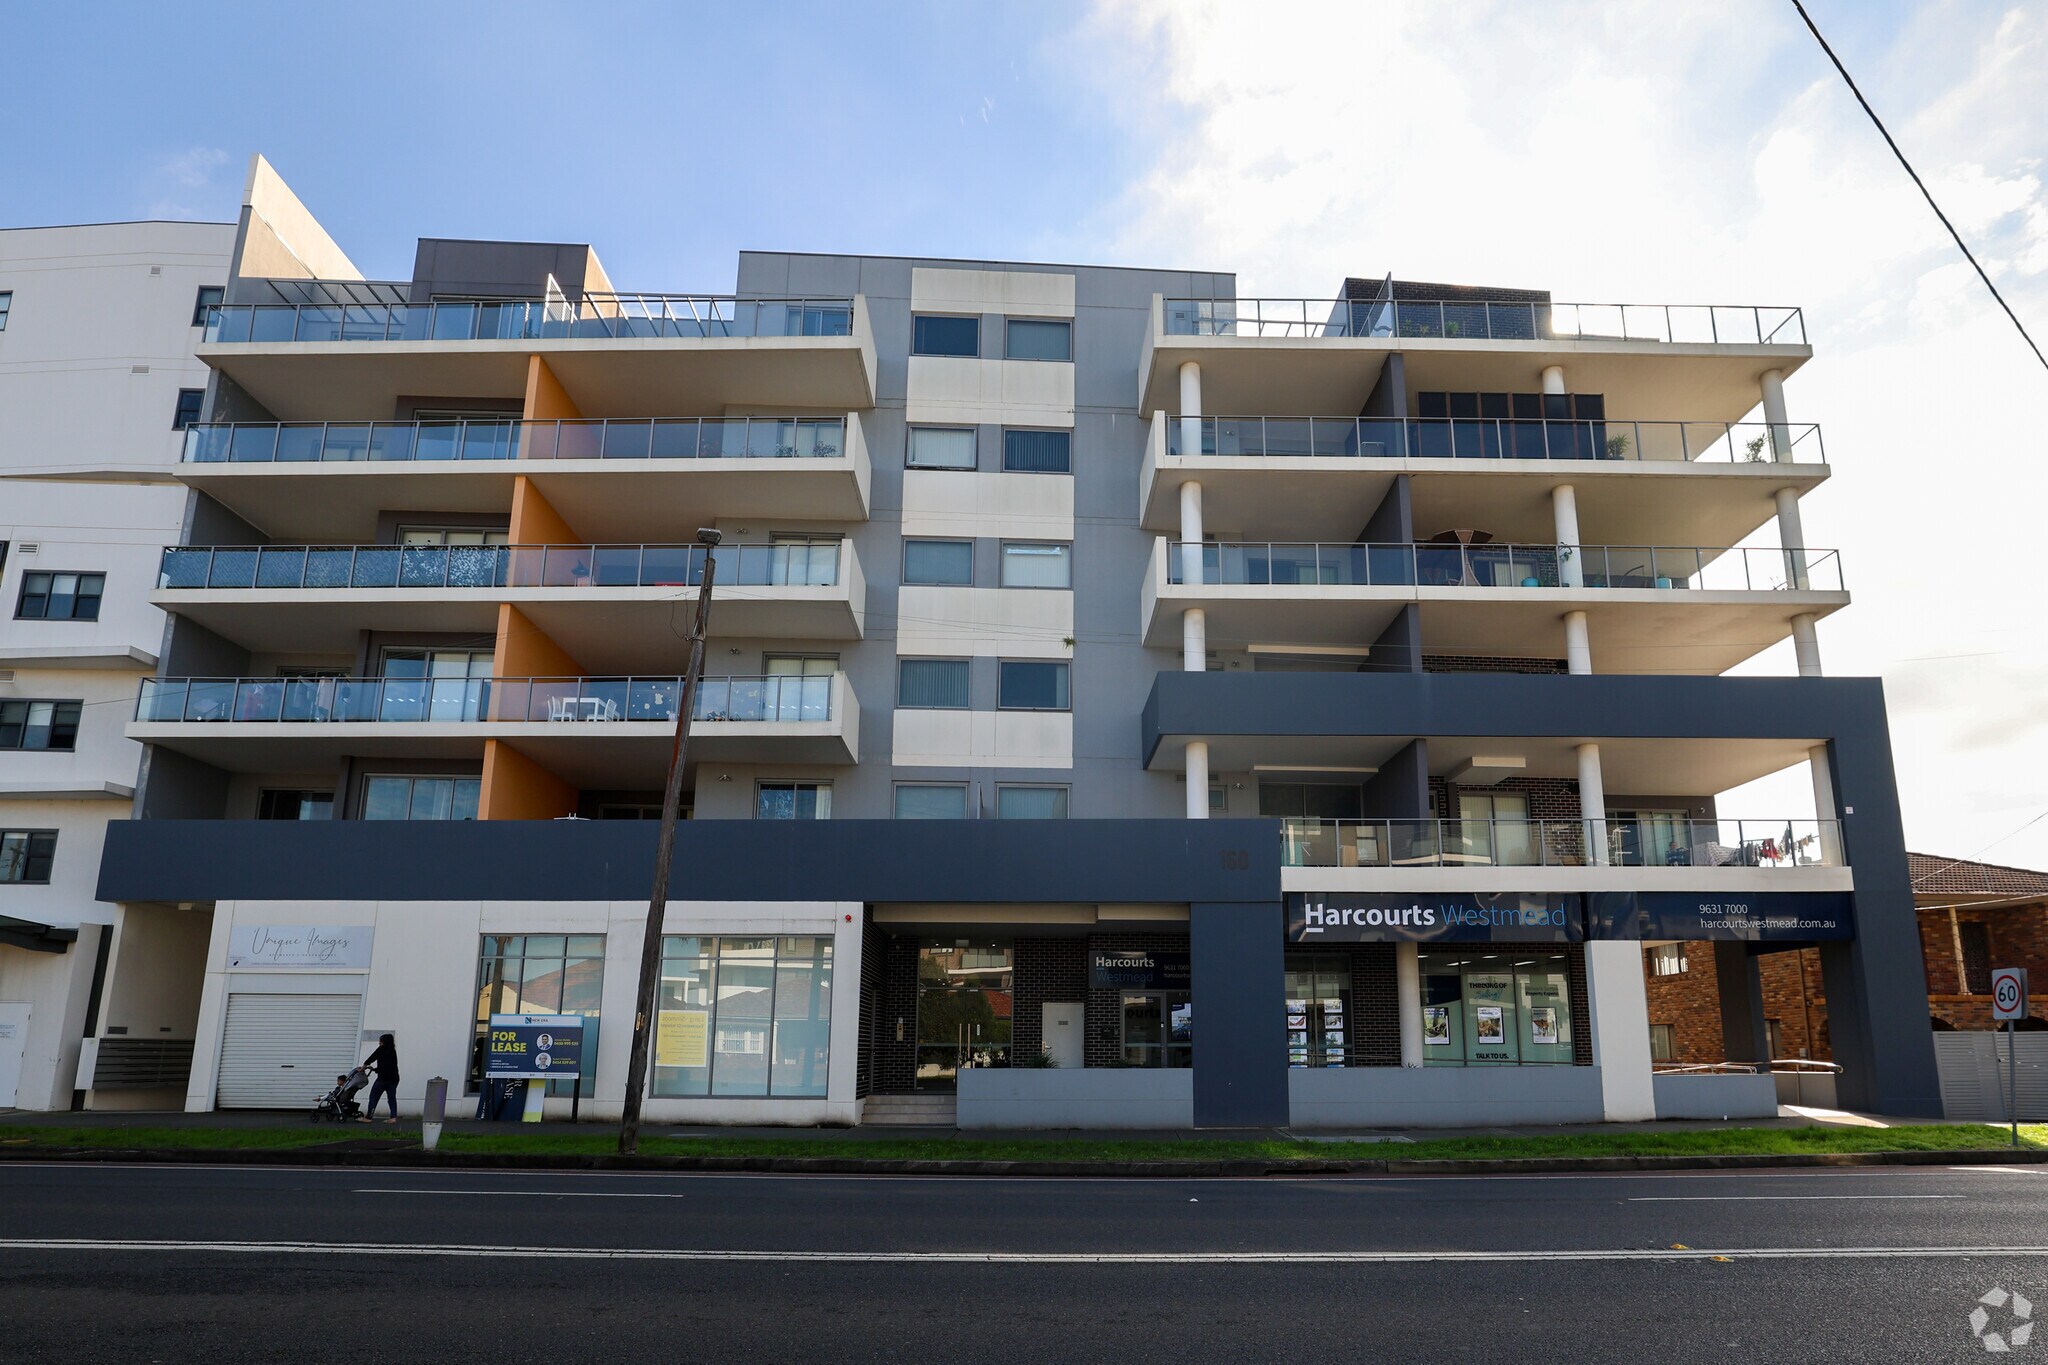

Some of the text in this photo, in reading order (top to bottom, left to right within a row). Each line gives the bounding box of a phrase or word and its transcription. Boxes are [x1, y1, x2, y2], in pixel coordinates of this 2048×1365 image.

[1305, 903, 1566, 926] Harcourts Westmead
[1699, 904, 1748, 914] 9631 7000
[1700, 918, 1836, 929] harcourtswestmead.com.au
[252, 928, 351, 961] Unique Images
[1095, 956, 1155, 968] Harcourts
[1096, 971, 1154, 982] Westmead
[1998, 985, 2016, 1002] 60
[492, 1031, 516, 1042] FOR
[491, 1042, 527, 1052] LEASE
